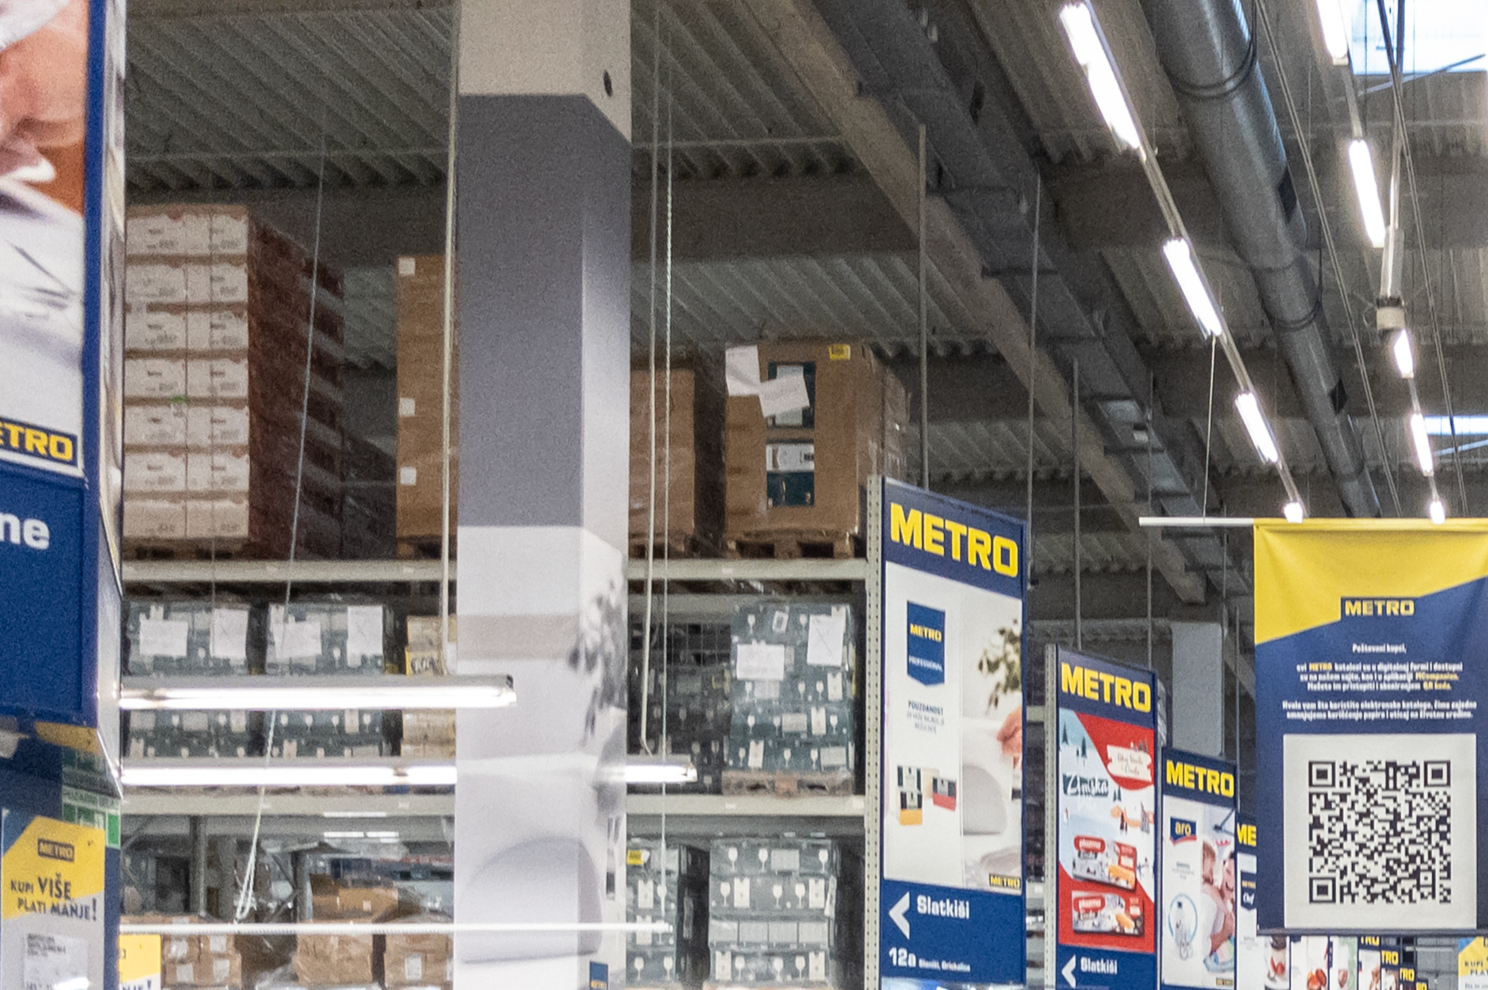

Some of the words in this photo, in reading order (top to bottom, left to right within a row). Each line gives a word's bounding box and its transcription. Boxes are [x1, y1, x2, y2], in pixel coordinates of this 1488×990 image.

[890, 502, 1018, 578] METRO
[1345, 600, 1415, 616] METRO
[909, 623, 942, 643] METRO
[1309, 662, 1332, 671] METRO
[1061, 662, 1151, 713] METRO
[1166, 760, 1234, 797] METRO
[1175, 822, 1191, 835] aro
[10, 880, 33, 894] KUPI
[17, 897, 46, 914] PLATI
[50, 898, 97, 921] MANJE!
[917, 895, 970, 919] Slatkiši
[889, 947, 917, 968] 12a
[1080, 956, 1117, 975] Slatkiši
